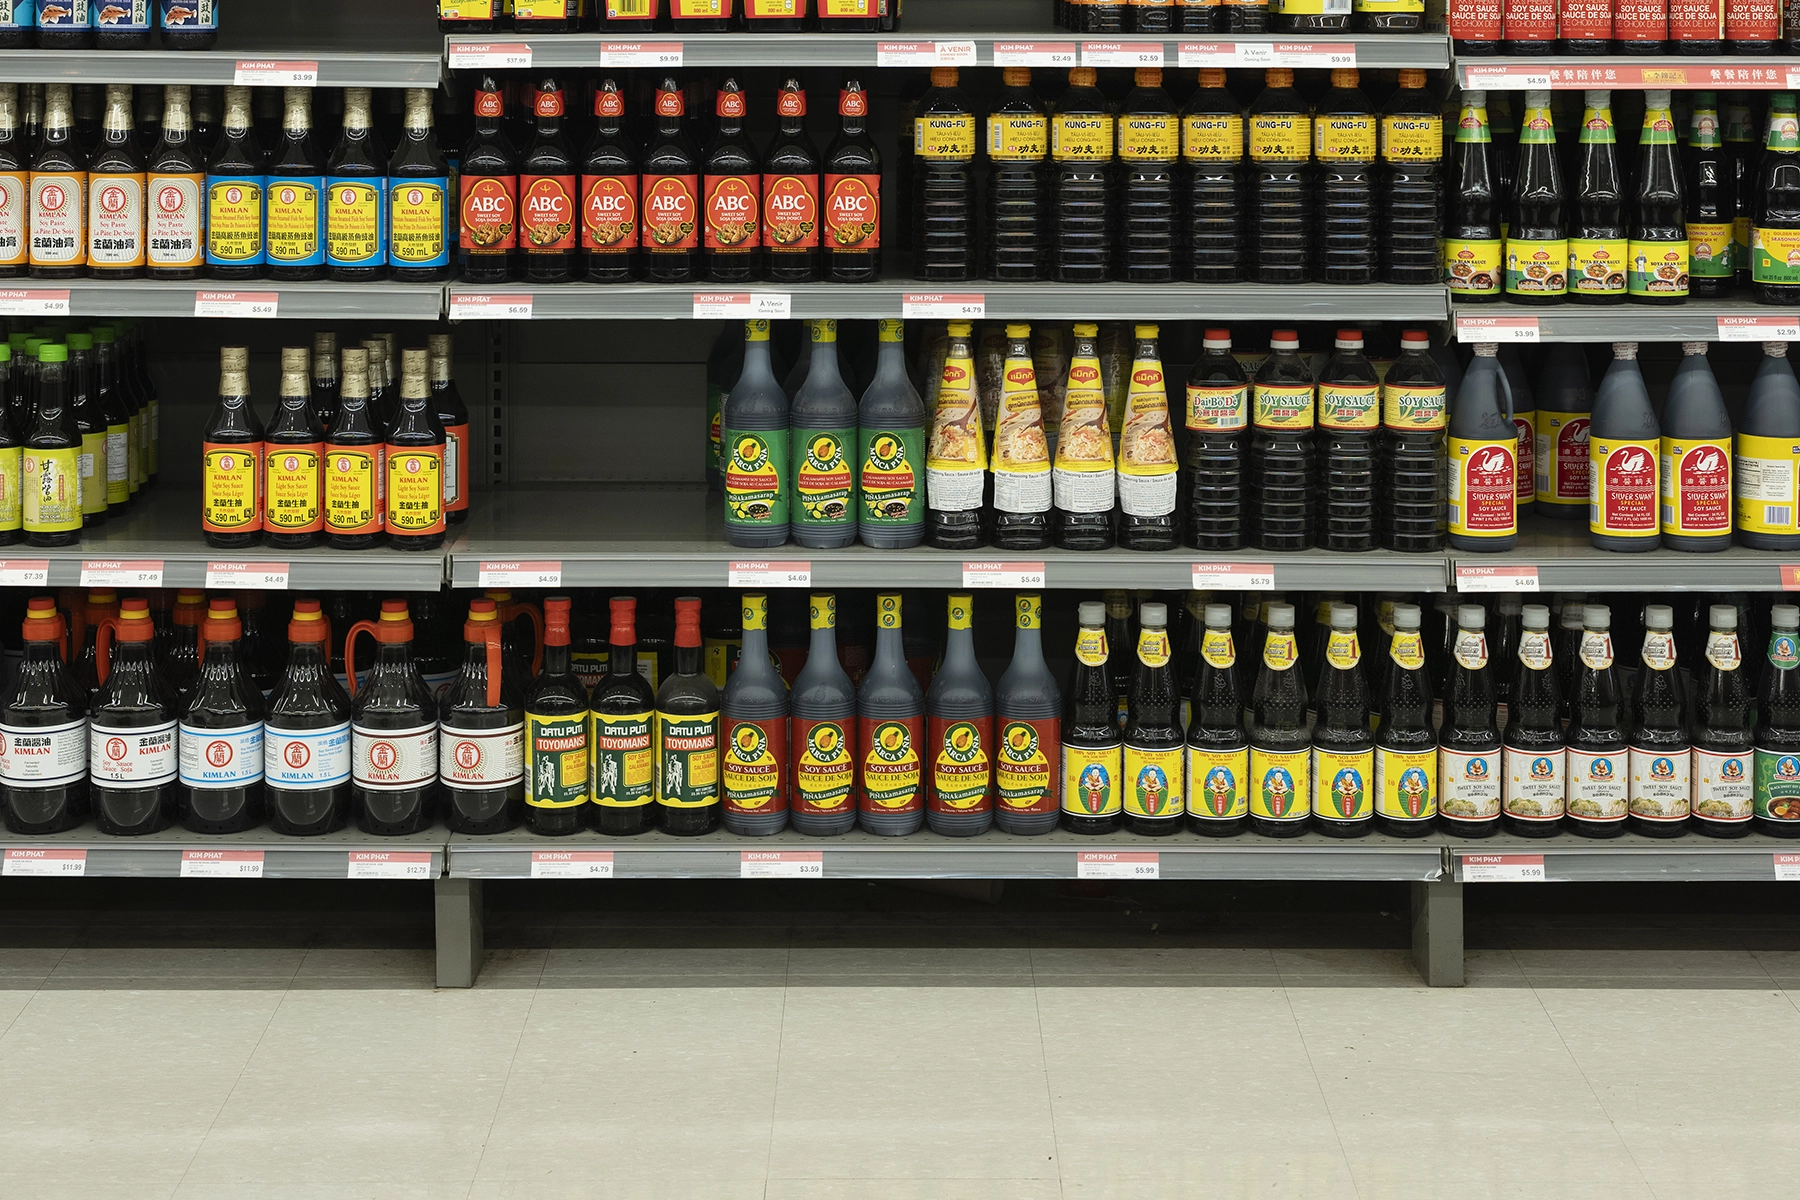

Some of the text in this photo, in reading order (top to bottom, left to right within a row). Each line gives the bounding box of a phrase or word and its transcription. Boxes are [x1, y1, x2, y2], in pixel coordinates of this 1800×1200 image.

[1710, 69, 1777, 80] 餐餐陪伴您
[930, 120, 966, 128] KUNG-FU
[1331, 121, 1367, 129] KUNG-FU
[938, 145, 960, 154] 功夫
[471, 197, 505, 212] ABC
[591, 196, 625, 210] ABC
[33, 237, 74, 248] 金蘭油膏
[220, 246, 247, 254] 590 mL
[1324, 395, 1375, 405] SOY SAUCE
[1473, 492, 1511, 501] SILVER SWAN
[215, 513, 241, 522] 590 mL
[670, 725, 711, 736] DATU PUTI
[14, 747, 50, 755] KIMLAN
[957, 764, 983, 772] SAUCE
[367, 772, 399, 780] KIMLAN
